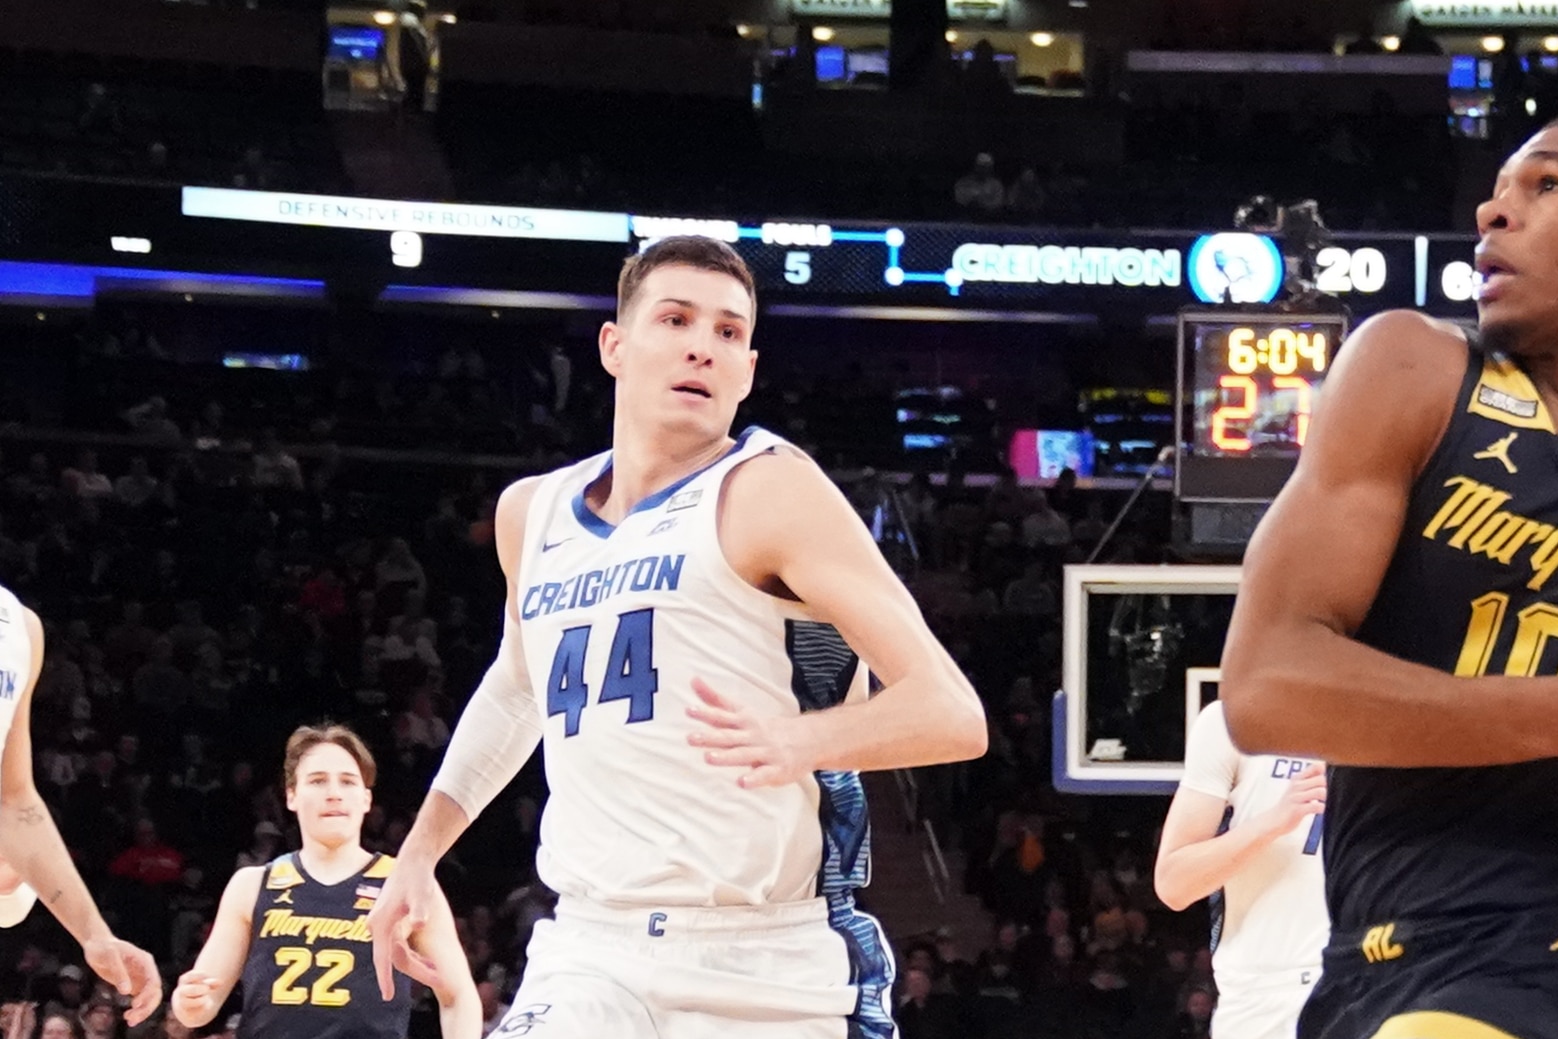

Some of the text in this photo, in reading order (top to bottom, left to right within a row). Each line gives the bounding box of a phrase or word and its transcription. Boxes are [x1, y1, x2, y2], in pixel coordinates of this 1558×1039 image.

[278, 199, 535, 231] DEFENSIVE REBOUNDS
[390, 230, 422, 268] 9
[784, 251, 812, 284] 5
[952, 243, 1181, 286] CREIGHTON
[1316, 247, 1387, 292] 20
[1228, 327, 1326, 375] 6:04
[1211, 375, 1312, 450] 27
[521, 554, 686, 621] CREIGHTON
[547, 606, 659, 739] 44
[648, 912, 668, 937] C
[271, 946, 355, 1007] 22
